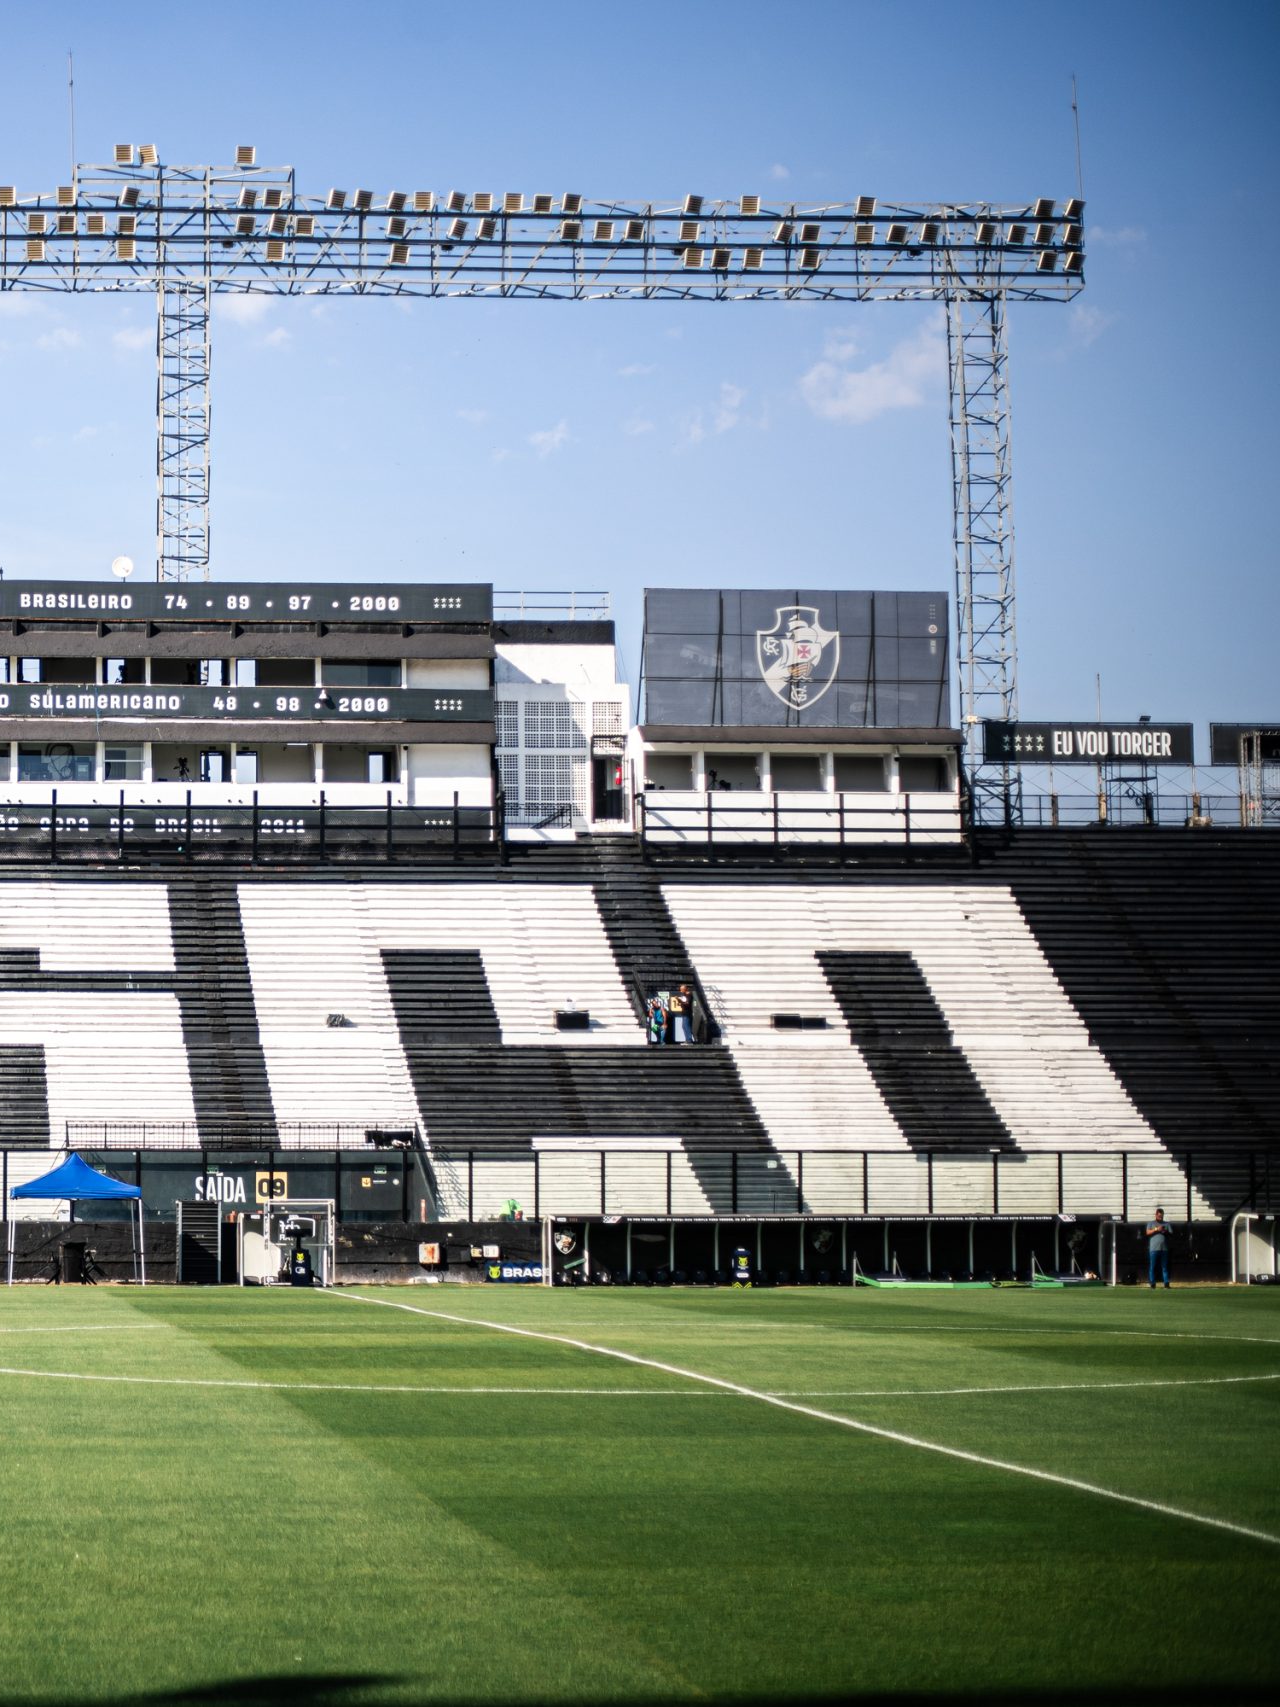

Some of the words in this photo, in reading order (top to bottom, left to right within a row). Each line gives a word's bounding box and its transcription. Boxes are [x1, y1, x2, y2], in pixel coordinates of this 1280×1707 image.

[164, 595, 188, 609] 74
[226, 595, 251, 610] 89
[288, 596, 311, 610] 97
[349, 597, 400, 611] 2000
[213, 697, 237, 711] 48
[276, 697, 300, 712] 98
[338, 698, 389, 712] 2000
[1053, 730, 1072, 755] EU
[1076, 731, 1109, 756] VOU
[1112, 731, 1172, 757] TORCER
[195, 1172, 247, 1203] SAÍDA
[258, 1178, 286, 1198] 09
